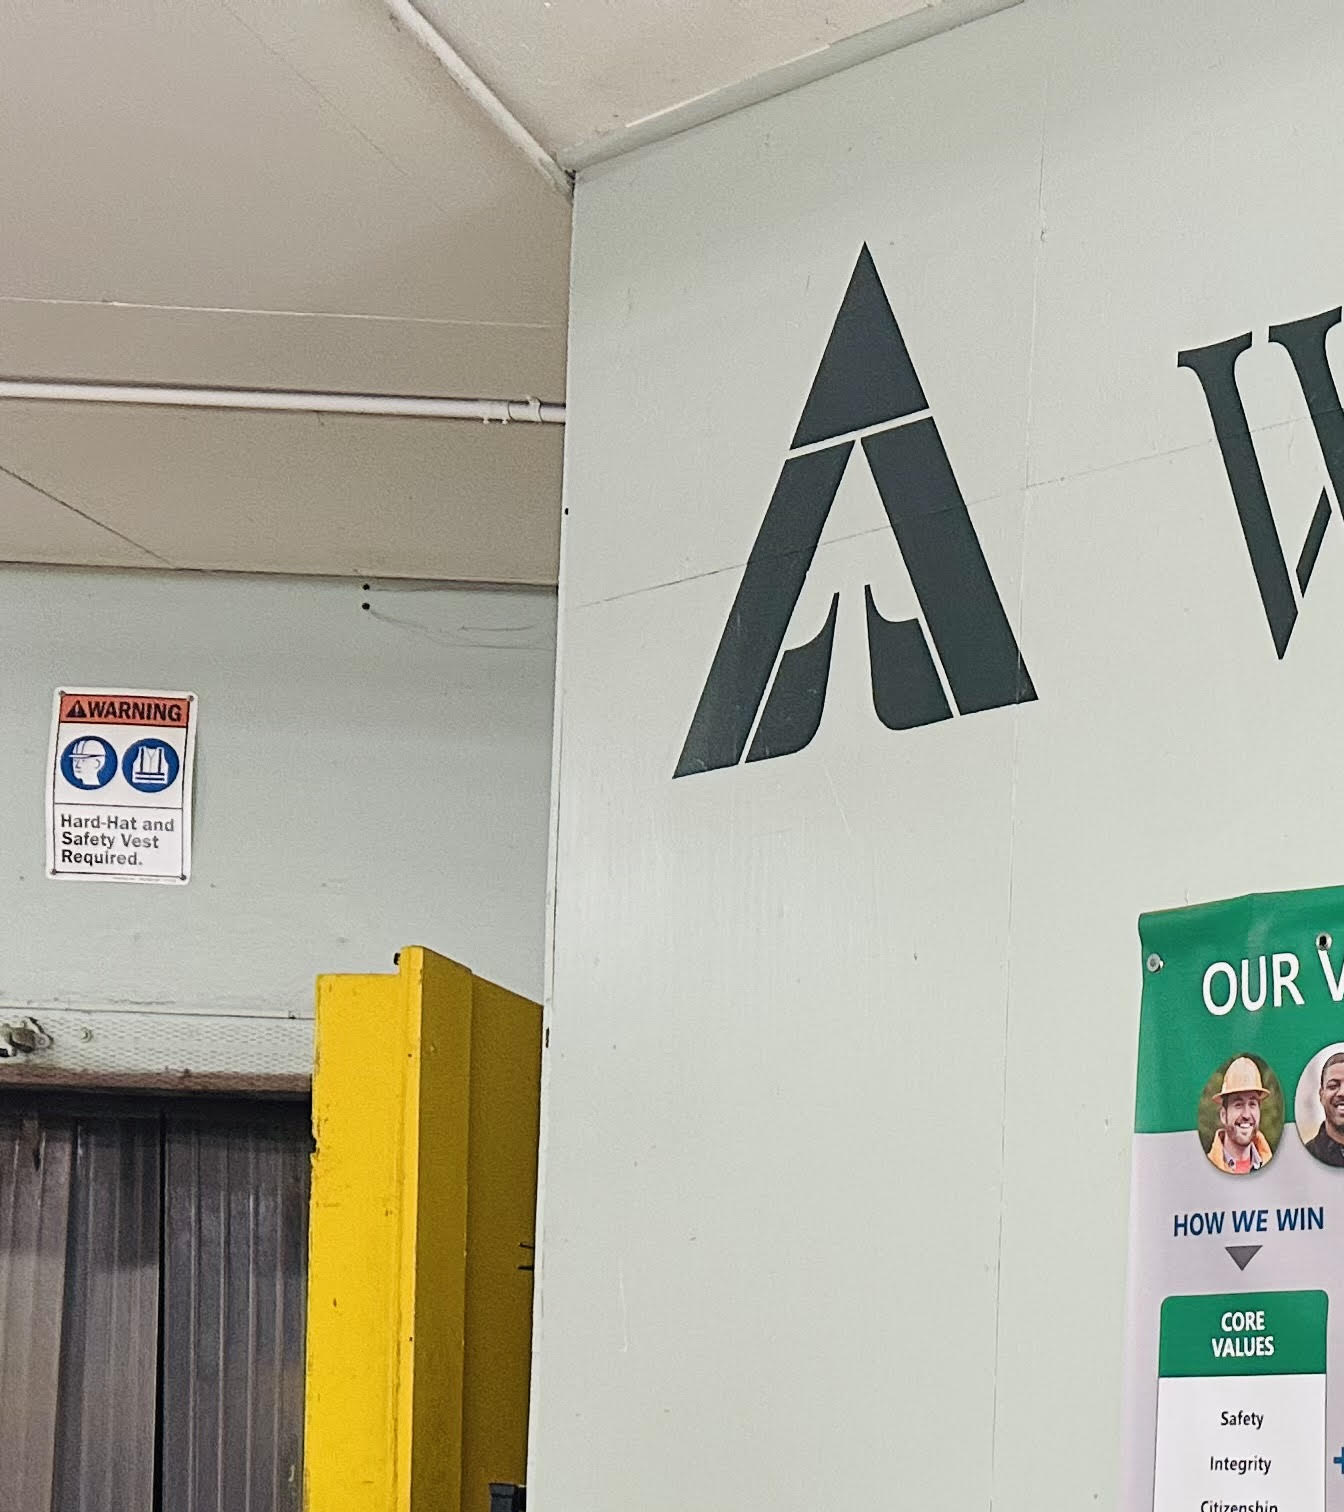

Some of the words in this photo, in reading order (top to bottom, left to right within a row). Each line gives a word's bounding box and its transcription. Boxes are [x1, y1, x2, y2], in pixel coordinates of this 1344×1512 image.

[88, 701, 181, 722] WARNING
[61, 813, 137, 831] Hard-Hat
[143, 818, 174, 832] and
[61, 831, 115, 849] Safety
[121, 833, 159, 849] Vest
[61, 849, 143, 867] Required.
[1202, 950, 1304, 1016] OUR
[1173, 1212, 1226, 1238] HOW
[1231, 1209, 1269, 1234] WE
[1275, 1206, 1325, 1233] WIN
[1221, 1310, 1266, 1333] CORE
[1211, 1335, 1275, 1358] VALUES
[1220, 1408, 1264, 1430] Safety
[1209, 1454, 1272, 1476] Integrity
